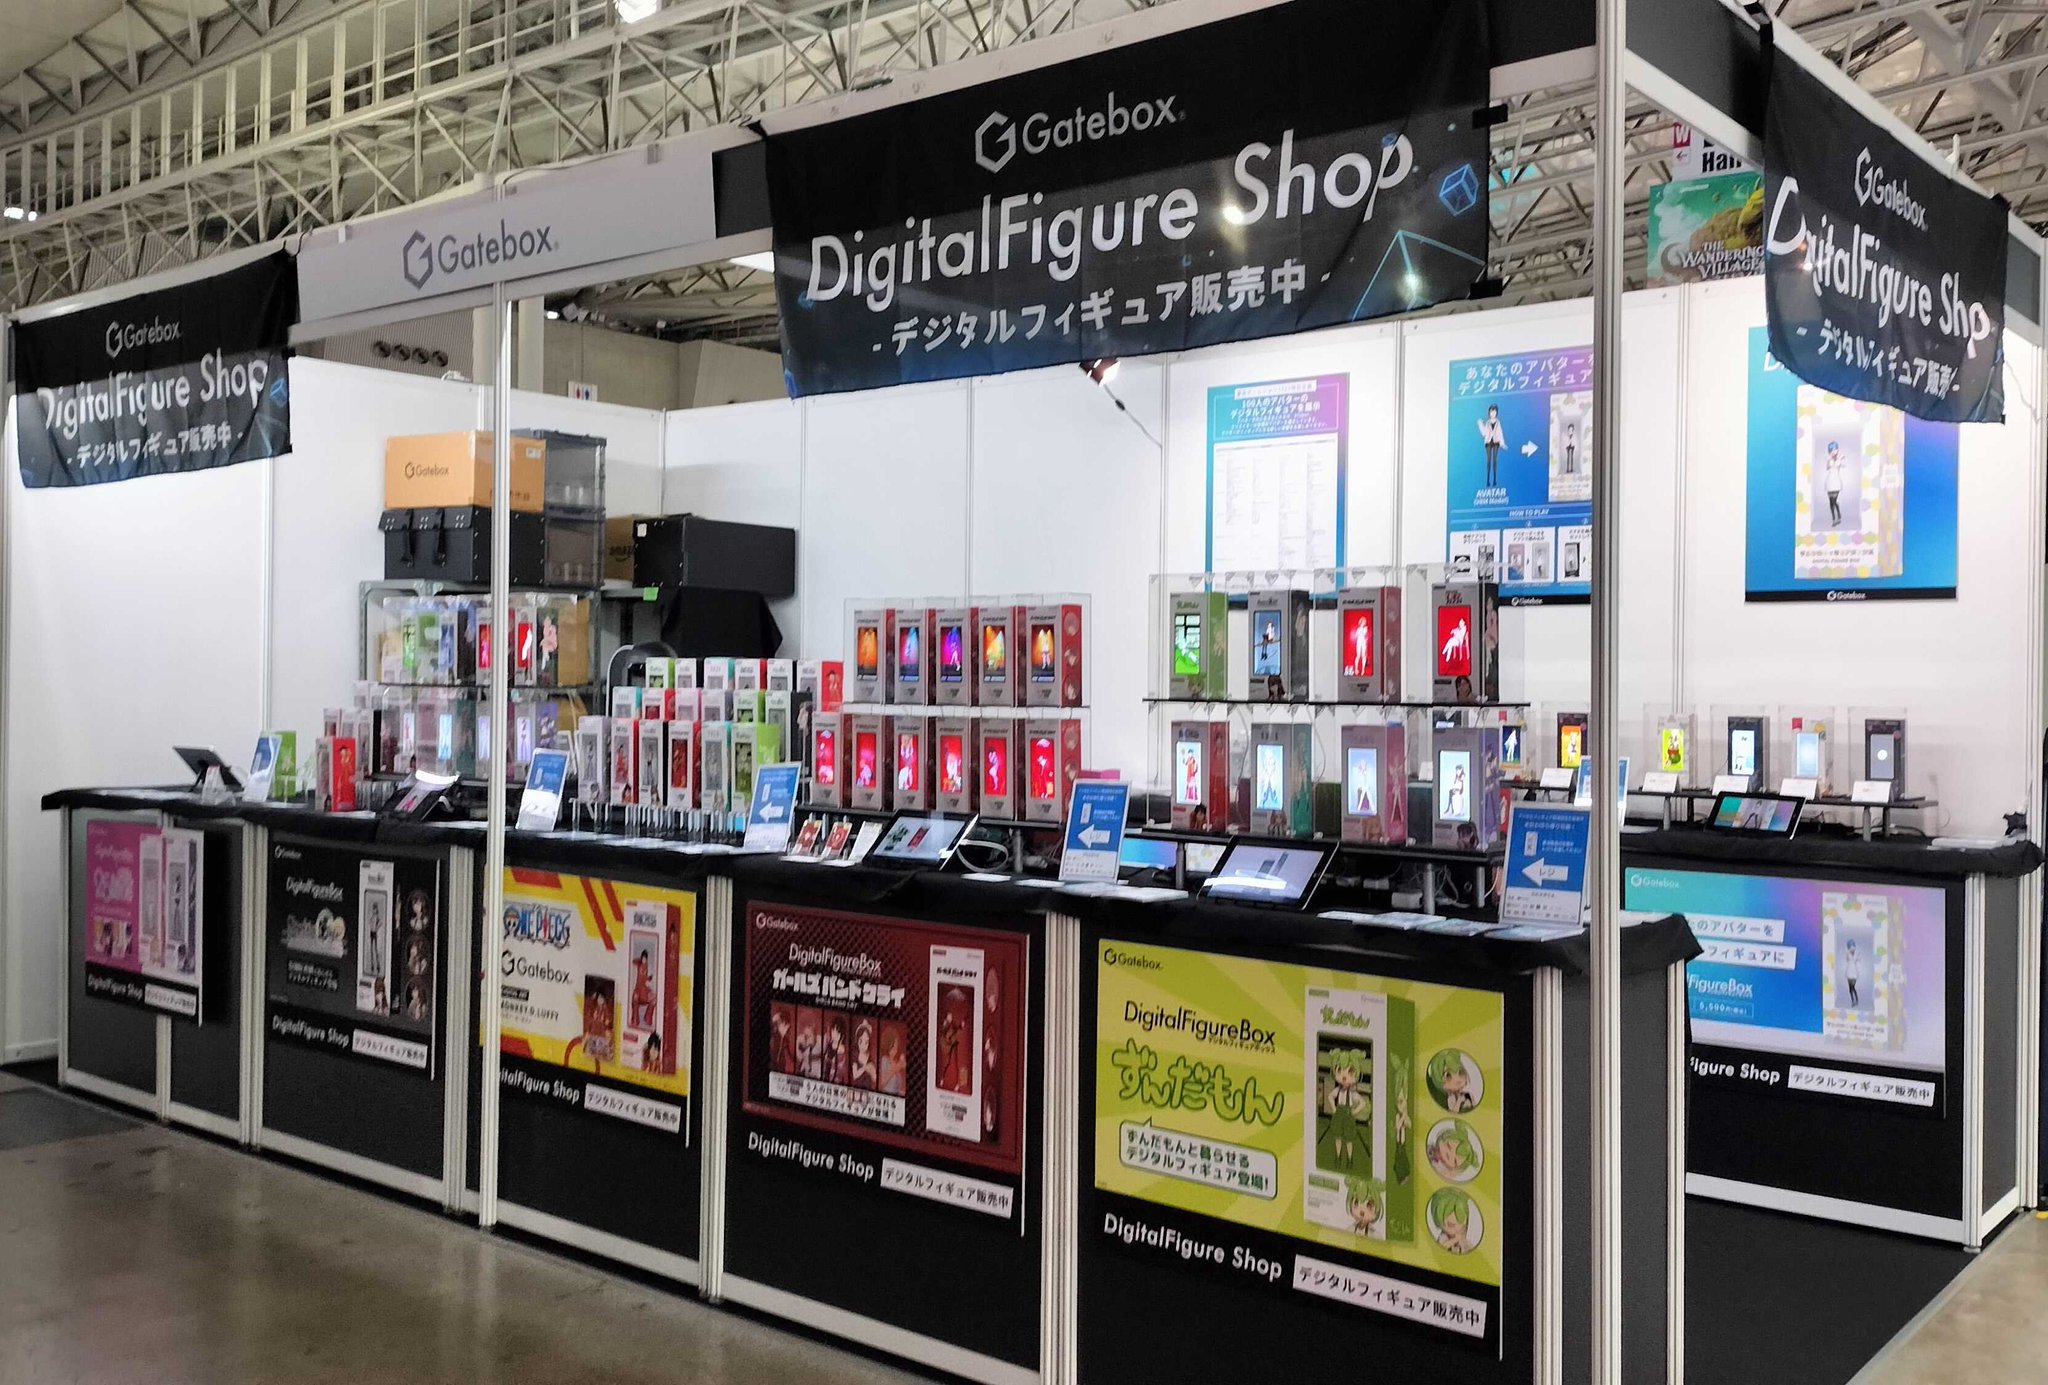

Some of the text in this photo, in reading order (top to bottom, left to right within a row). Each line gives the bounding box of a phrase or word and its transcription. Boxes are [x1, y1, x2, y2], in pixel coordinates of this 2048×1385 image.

[1022, 92, 1177, 155] Gatebox
[1871, 166, 1927, 230] Gatebox
[807, 130, 1414, 312] DigitalFigure Shop
[438, 218, 552, 274] Gatebox
[1682, 245, 1765, 268] WANDERING
[1703, 241, 1725, 251] THE
[1698, 258, 1758, 280] VILLAGE
[890, 260, 1306, 356] デジタルフィギュア販売中
[124, 316, 181, 348] Gatebox
[200, 347, 268, 409] Shop
[77, 421, 232, 468] デジタルフィギュア販売中
[416, 463, 449, 477] Gatebox
[1539, 868, 1556, 877] レジ
[1642, 877, 1680, 889] Gatebox
[766, 915, 798, 931] Gatebox
[516, 957, 571, 984] Gatebox
[789, 943, 881, 972] DigitalFigureBox
[1117, 952, 1161, 970] Gatebox
[272, 1015, 350, 1049] DigitalFigure Shop
[1124, 1000, 1276, 1046] DigitalFigureBox
[553, 1080, 580, 1105] Shop
[1111, 1038, 1285, 1127] ずんだもん
[1740, 1063, 1781, 1085] Shop
[749, 1131, 874, 1183] DigitalFigure Shop
[1126, 1129, 1250, 1169] ずんだもんと暮らせる
[884, 1164, 1010, 1210] デジタルフィギュア販売中
[1103, 1211, 1283, 1281] DigitalFigure Shop
[1298, 1265, 1481, 1327] デジタルフィギュア販売中
